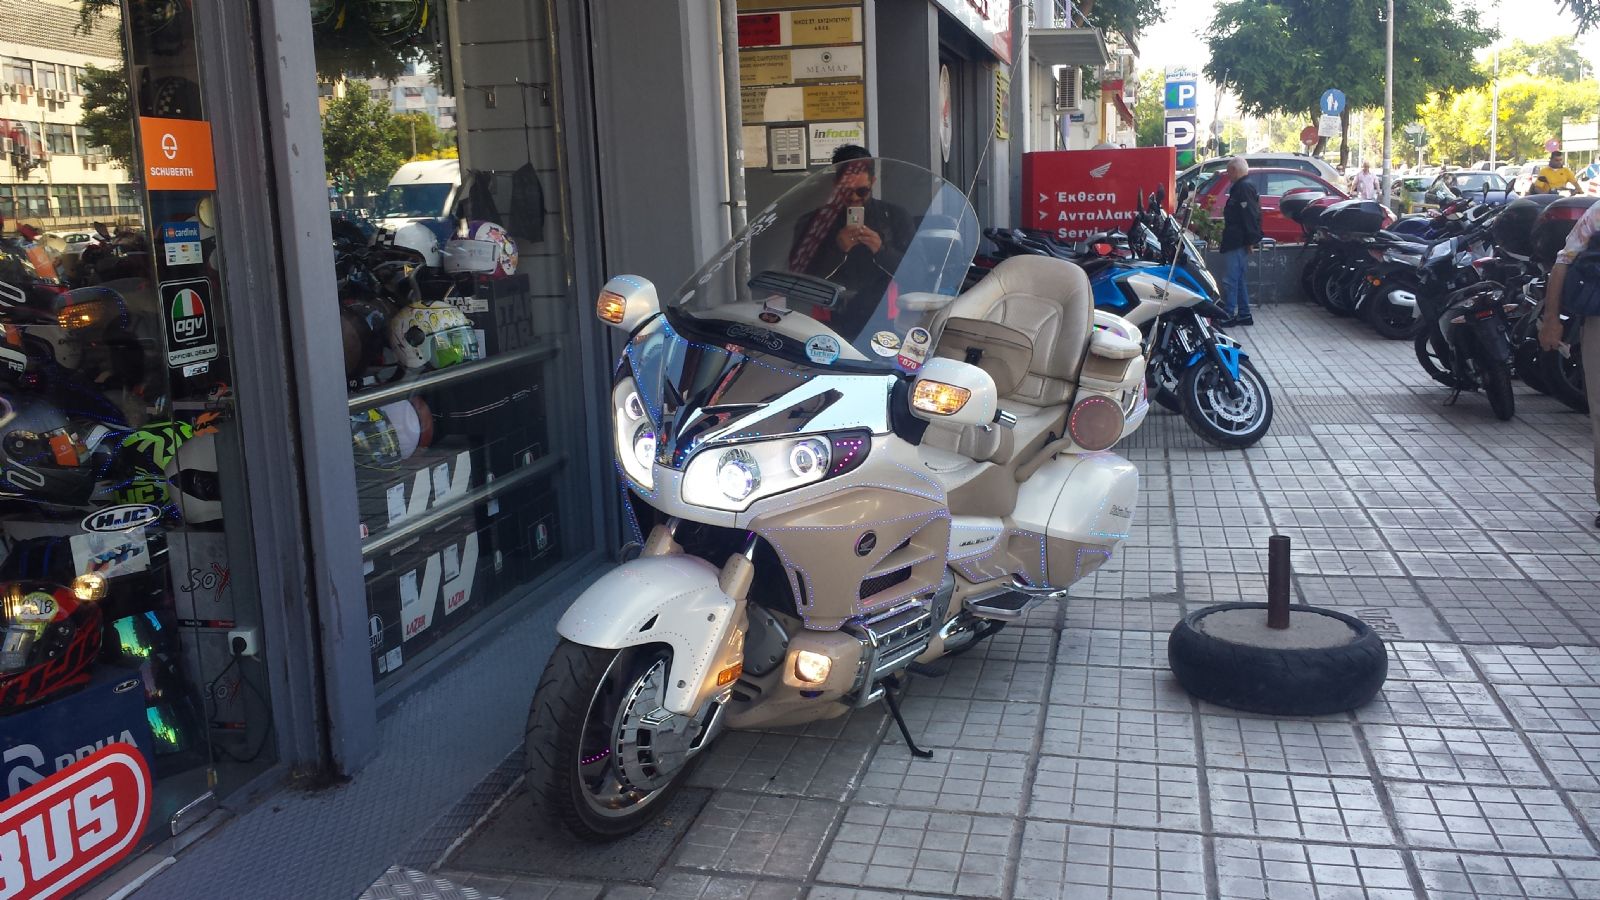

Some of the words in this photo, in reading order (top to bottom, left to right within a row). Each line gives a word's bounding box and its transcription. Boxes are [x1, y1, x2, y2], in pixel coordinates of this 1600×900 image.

[1178, 84, 1195, 107] P
[813, 128, 860, 139] infocus
[1166, 120, 1195, 148] P
[150, 166, 194, 178] SCHUBERTH
[1055, 191, 1116, 204] Έκθεση
[175, 317, 203, 337] agv
[97, 508, 149, 528] HJC
